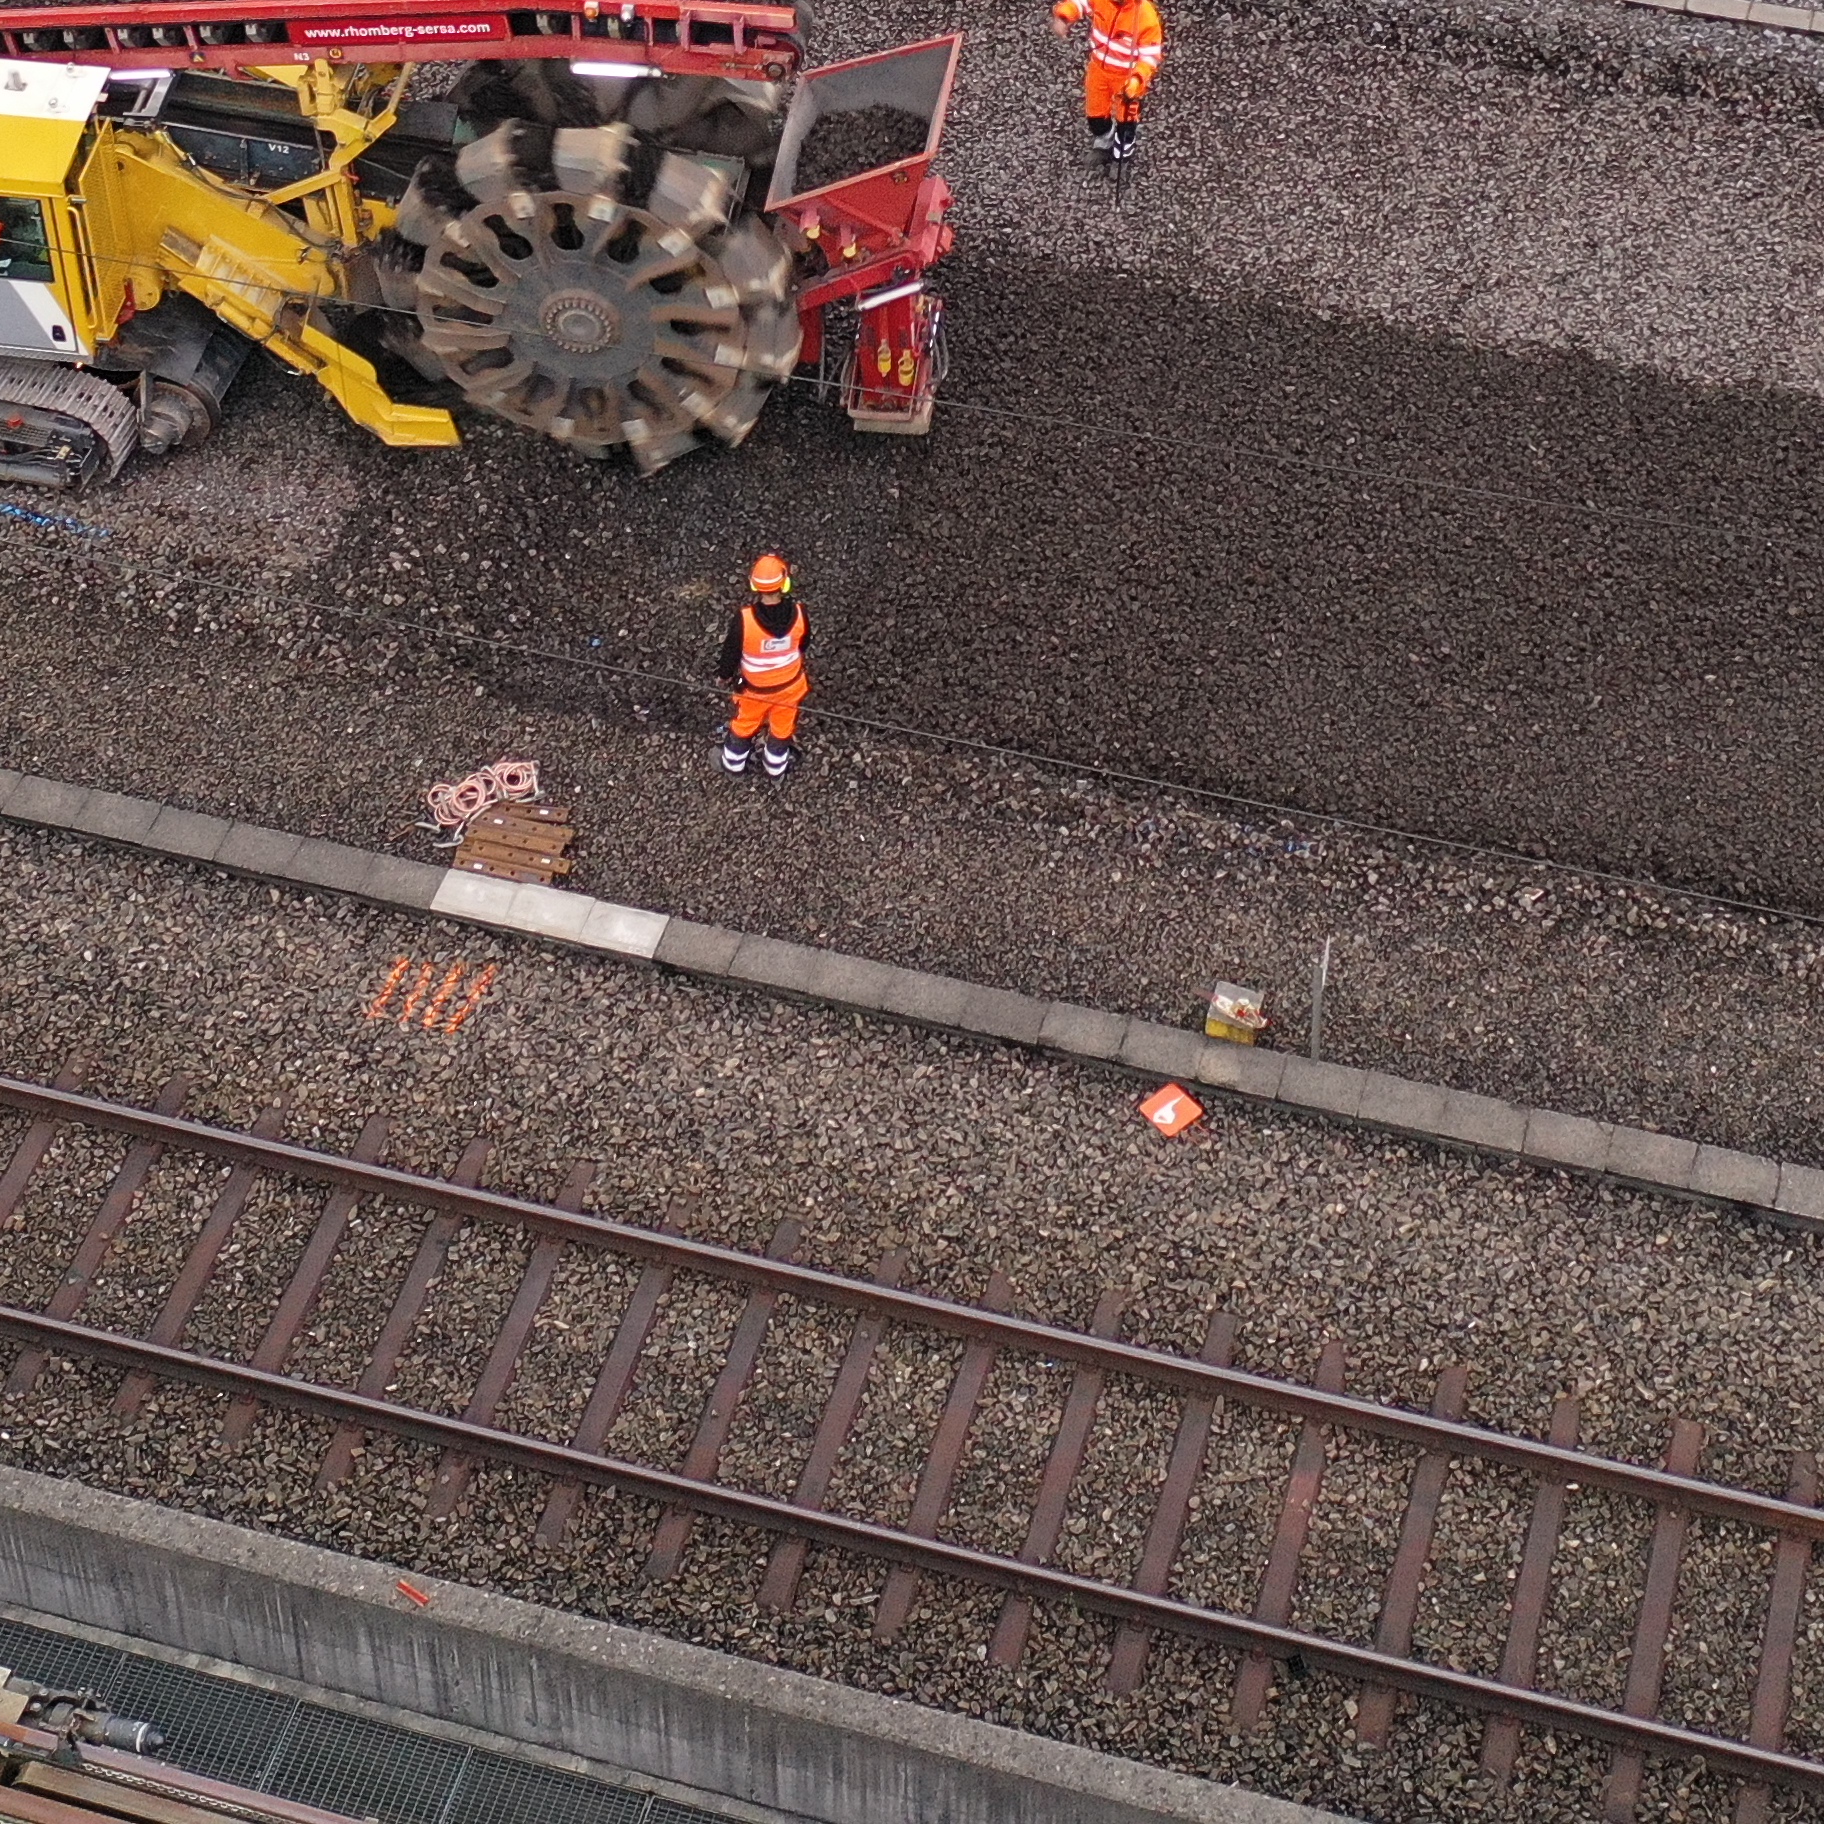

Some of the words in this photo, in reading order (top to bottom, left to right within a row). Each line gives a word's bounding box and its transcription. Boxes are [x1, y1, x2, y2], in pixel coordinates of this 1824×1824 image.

[304, 22, 491, 39] www.rhomberg-sersa.com
[293, 52, 310, 61] N3
[268, 143, 290, 154] V12
